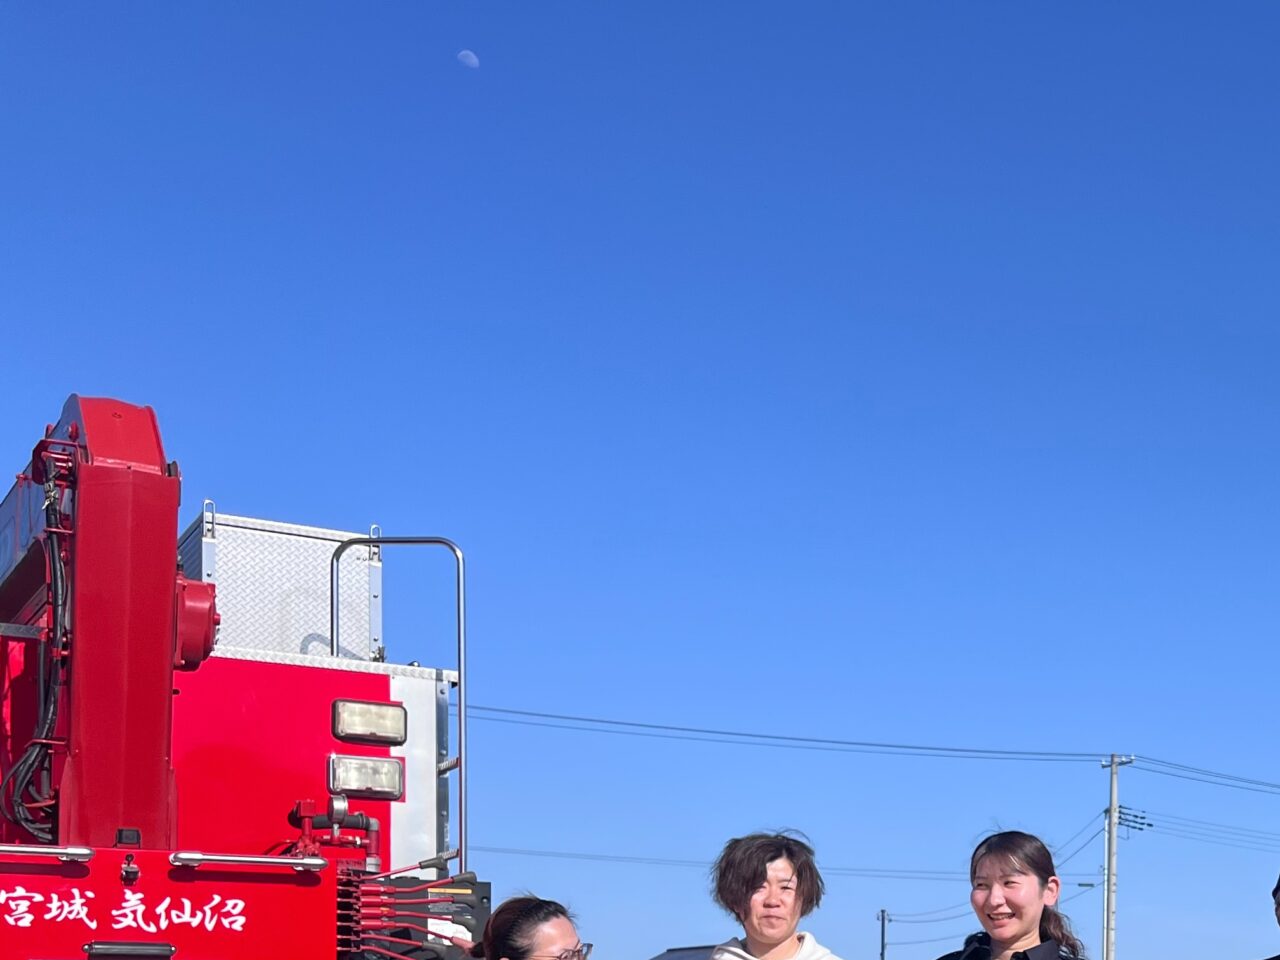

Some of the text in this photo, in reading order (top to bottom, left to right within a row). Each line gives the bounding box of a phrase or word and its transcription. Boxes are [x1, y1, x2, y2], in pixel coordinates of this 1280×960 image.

[0, 886, 247, 933] 宮城 気仙沼
